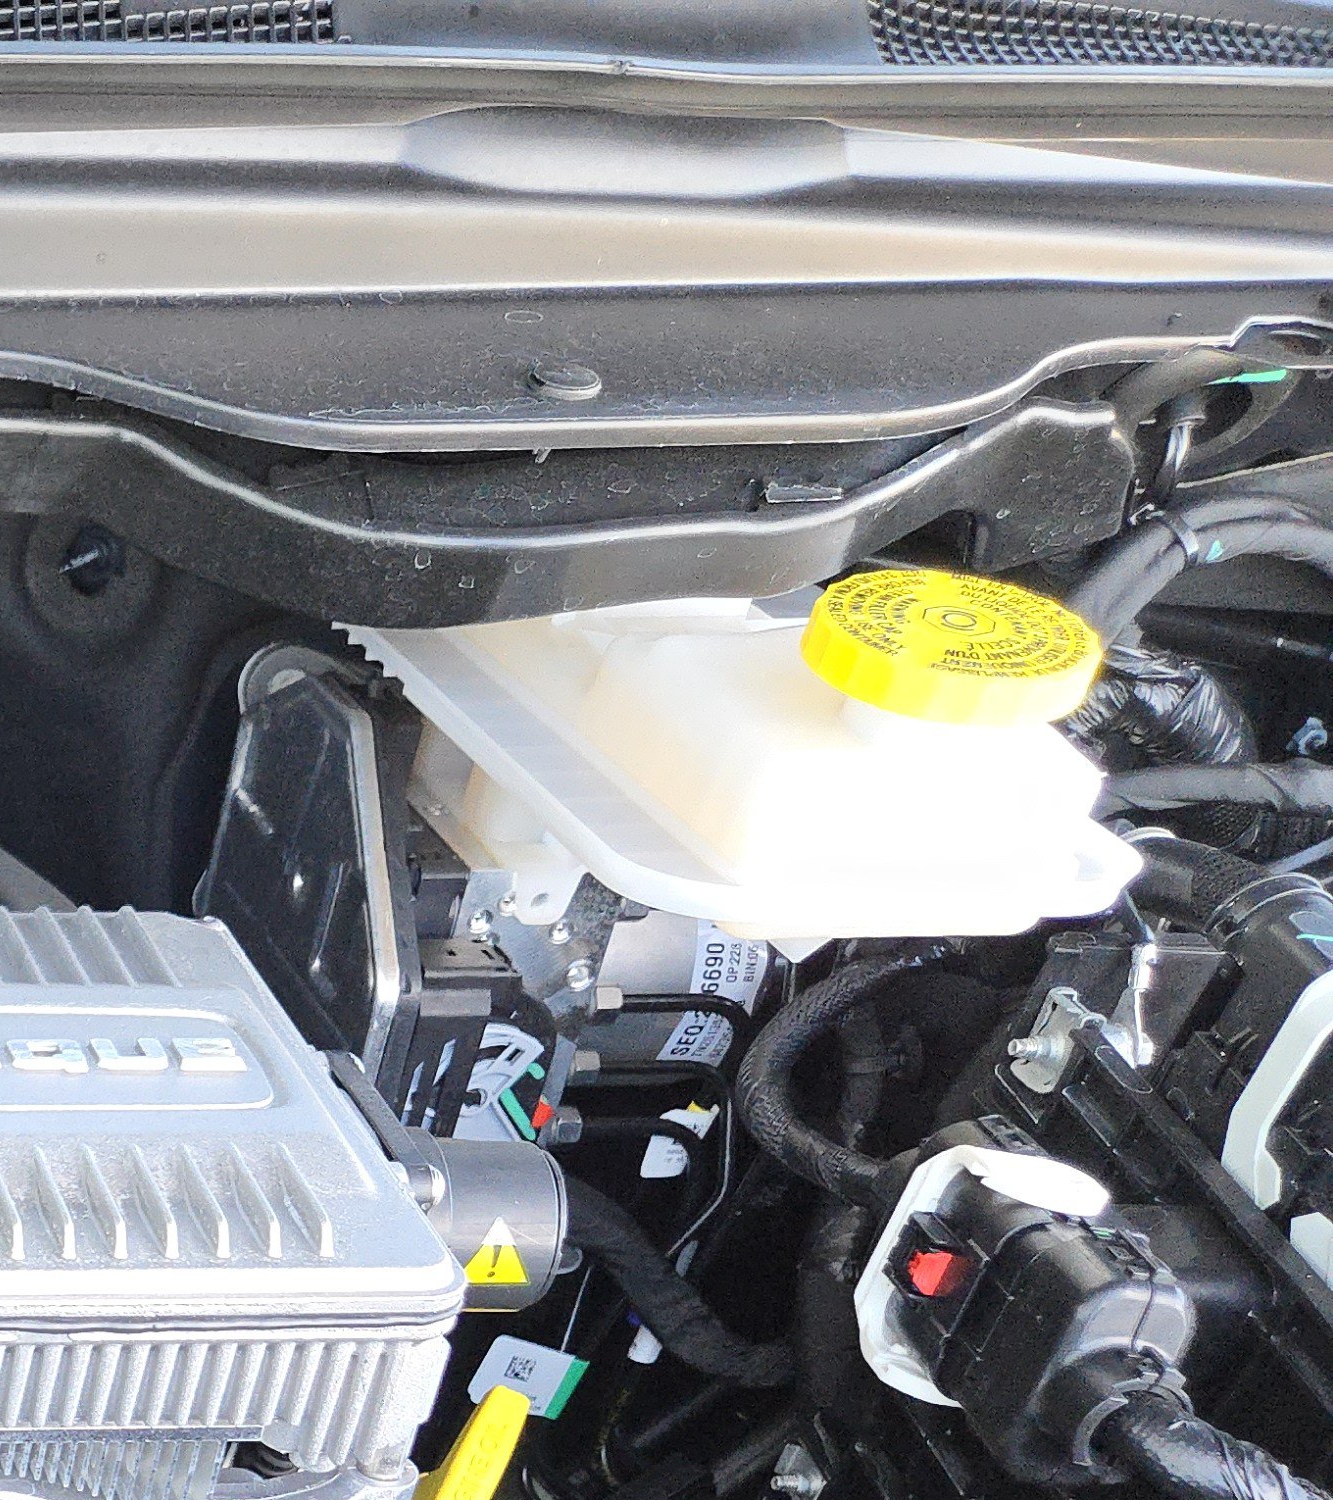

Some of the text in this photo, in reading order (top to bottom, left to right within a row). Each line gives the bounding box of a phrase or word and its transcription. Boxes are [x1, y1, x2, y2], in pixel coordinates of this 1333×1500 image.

[960, 581, 1008, 597] AVANT
[960, 589, 982, 600] DU
[942, 648, 982, 660] D'UN
